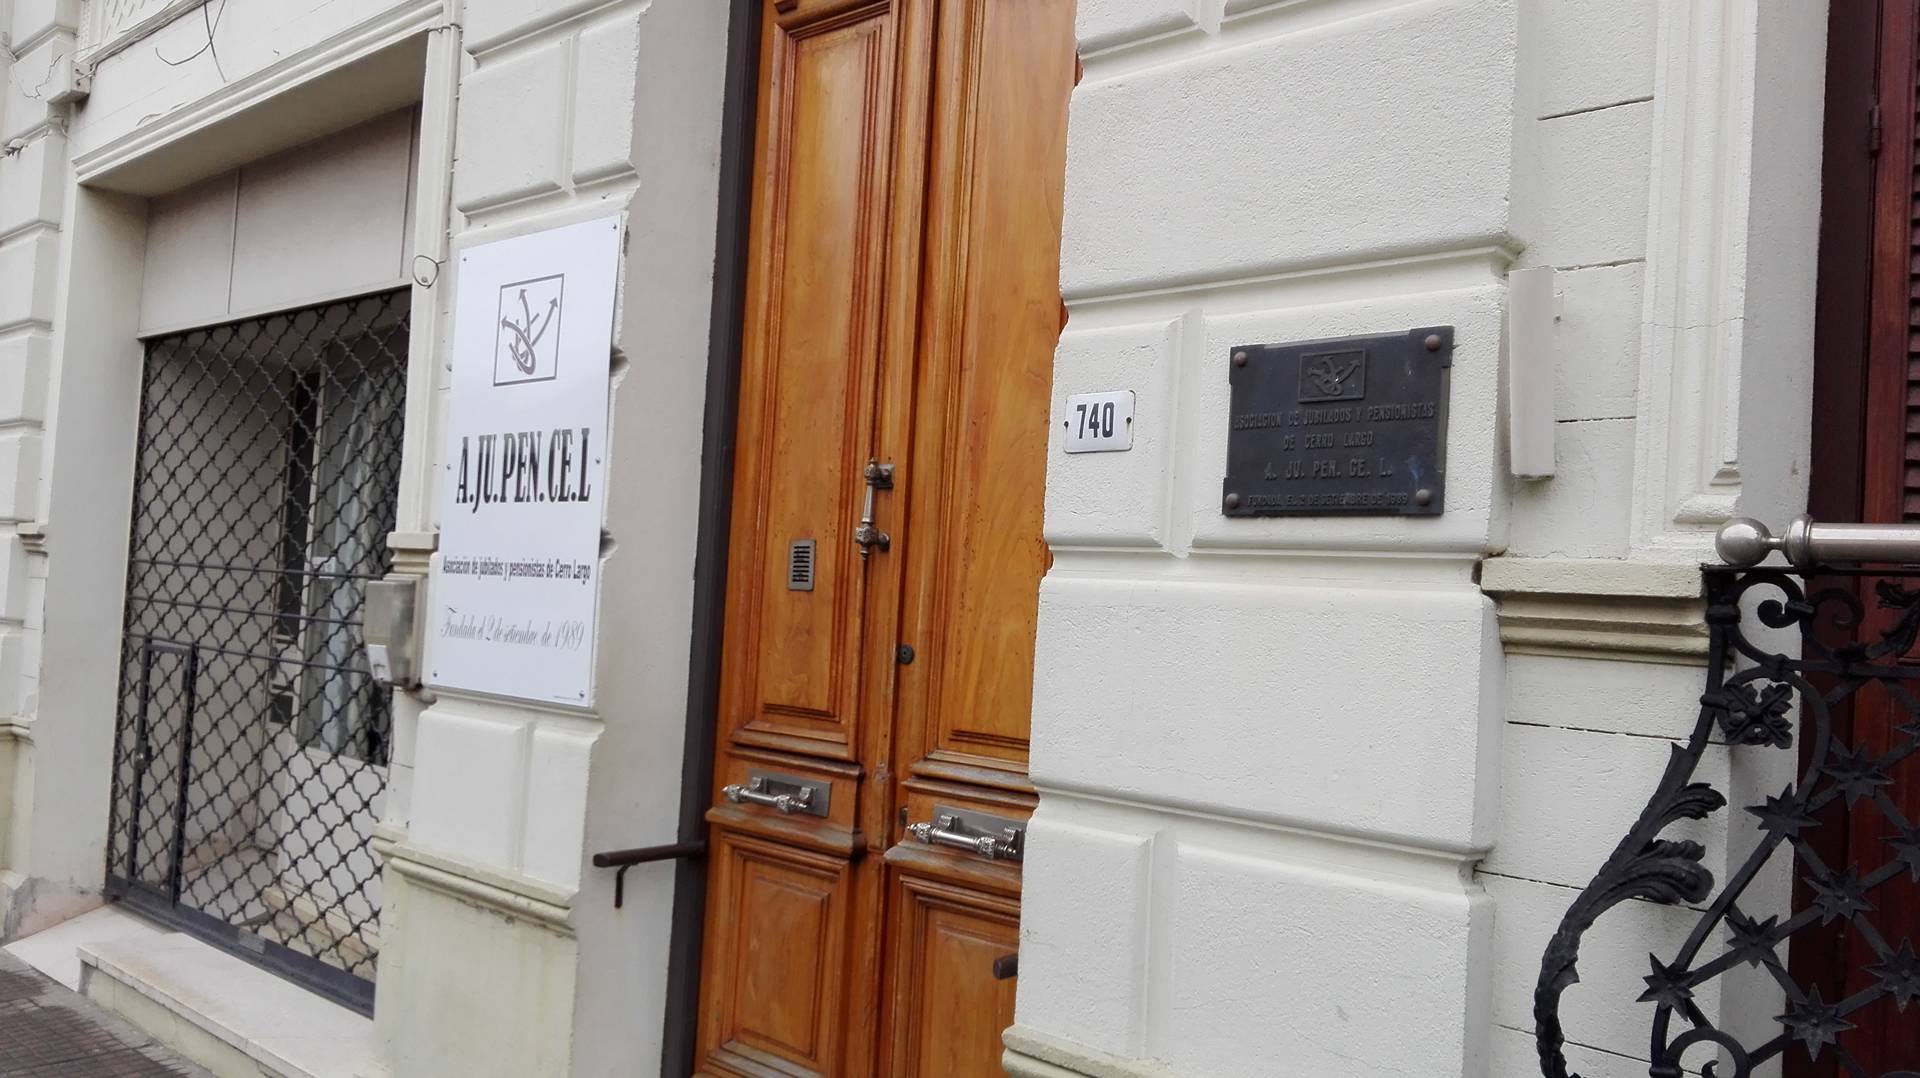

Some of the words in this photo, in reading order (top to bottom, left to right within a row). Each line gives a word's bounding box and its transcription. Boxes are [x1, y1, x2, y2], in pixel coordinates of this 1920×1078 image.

[1077, 402, 1114, 439] 740
[1288, 410, 1299, 426] DE
[1303, 408, 1351, 425] JUBILADOS
[1367, 403, 1434, 422] PENSIONISTAS
[1282, 434, 1295, 451] DE
[1304, 432, 1334, 449] CERRO
[1343, 431, 1374, 448] LARGO
[1312, 460, 1341, 479] PEN.
[471, 556, 478, 574] de
[478, 556, 503, 580] jubilados
[508, 558, 545, 581] pensionistas
[546, 560, 553, 578] de
[555, 558, 571, 579] Cerro
[573, 559, 591, 585] Largo
[541, 620, 552, 647] de
[554, 619, 585, 652] 1989
